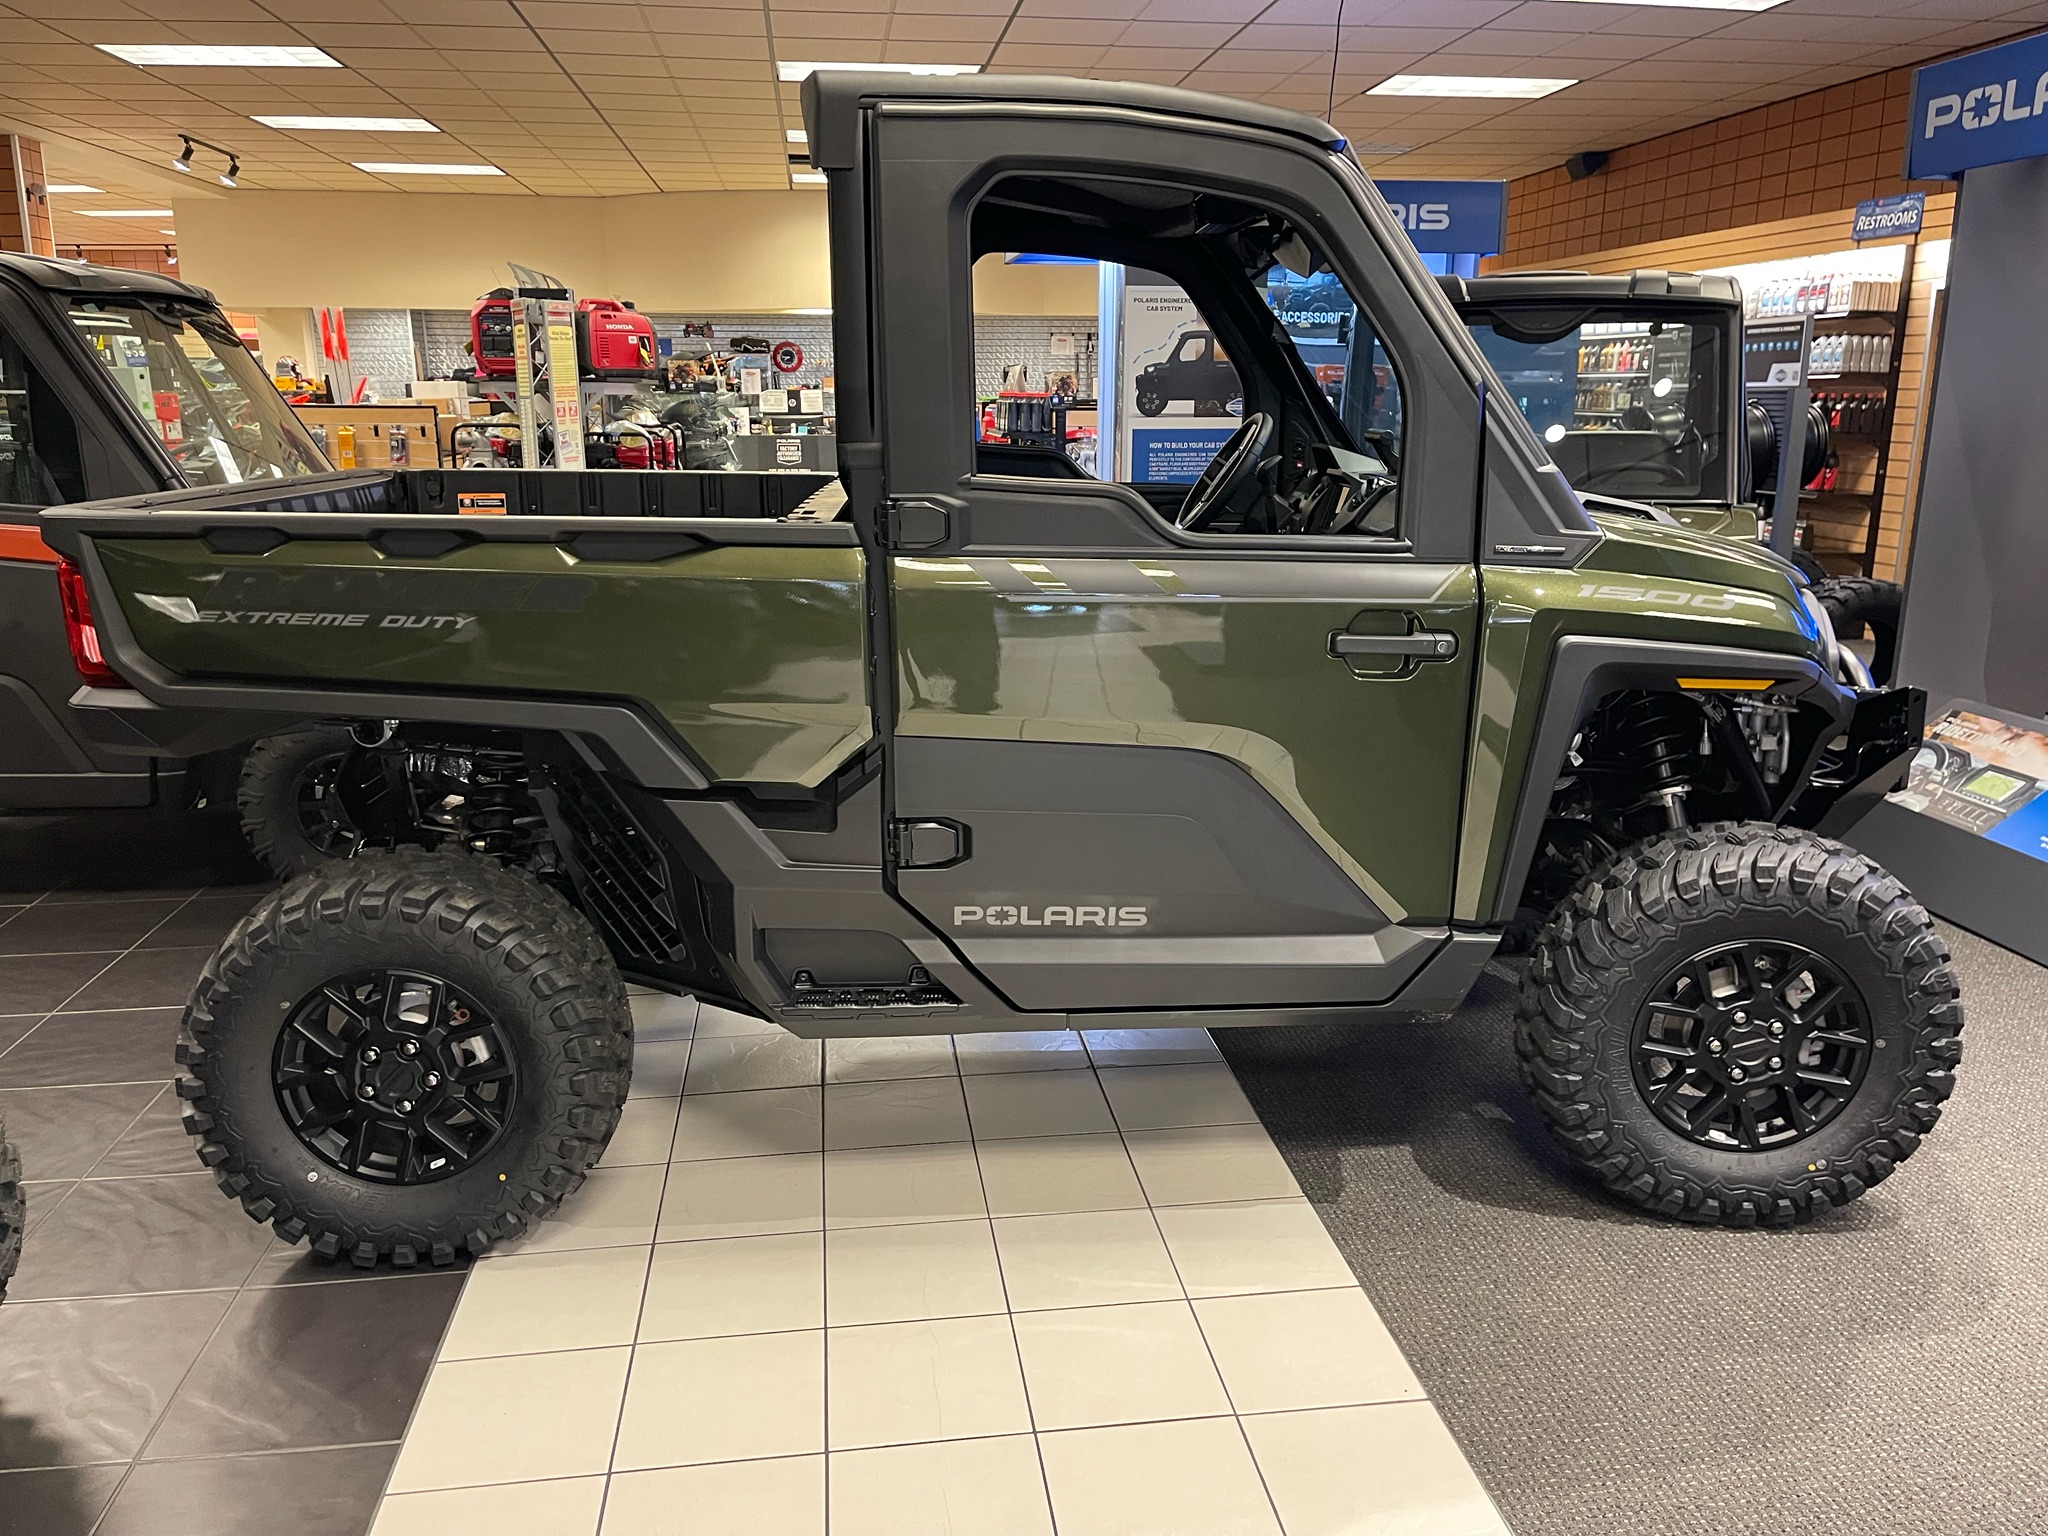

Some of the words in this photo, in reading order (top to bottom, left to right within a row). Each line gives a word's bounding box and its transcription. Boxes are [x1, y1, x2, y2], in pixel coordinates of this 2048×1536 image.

[1856, 209, 1919, 232] RESTROOMS
[605, 323, 634, 331] HONDA
[1281, 310, 1350, 324] ACCESSORI
[1577, 583, 1736, 611] 1500
[196, 610, 371, 628] EXTREME
[378, 614, 478, 630] DUTY
[953, 905, 1148, 927] POLARIS
